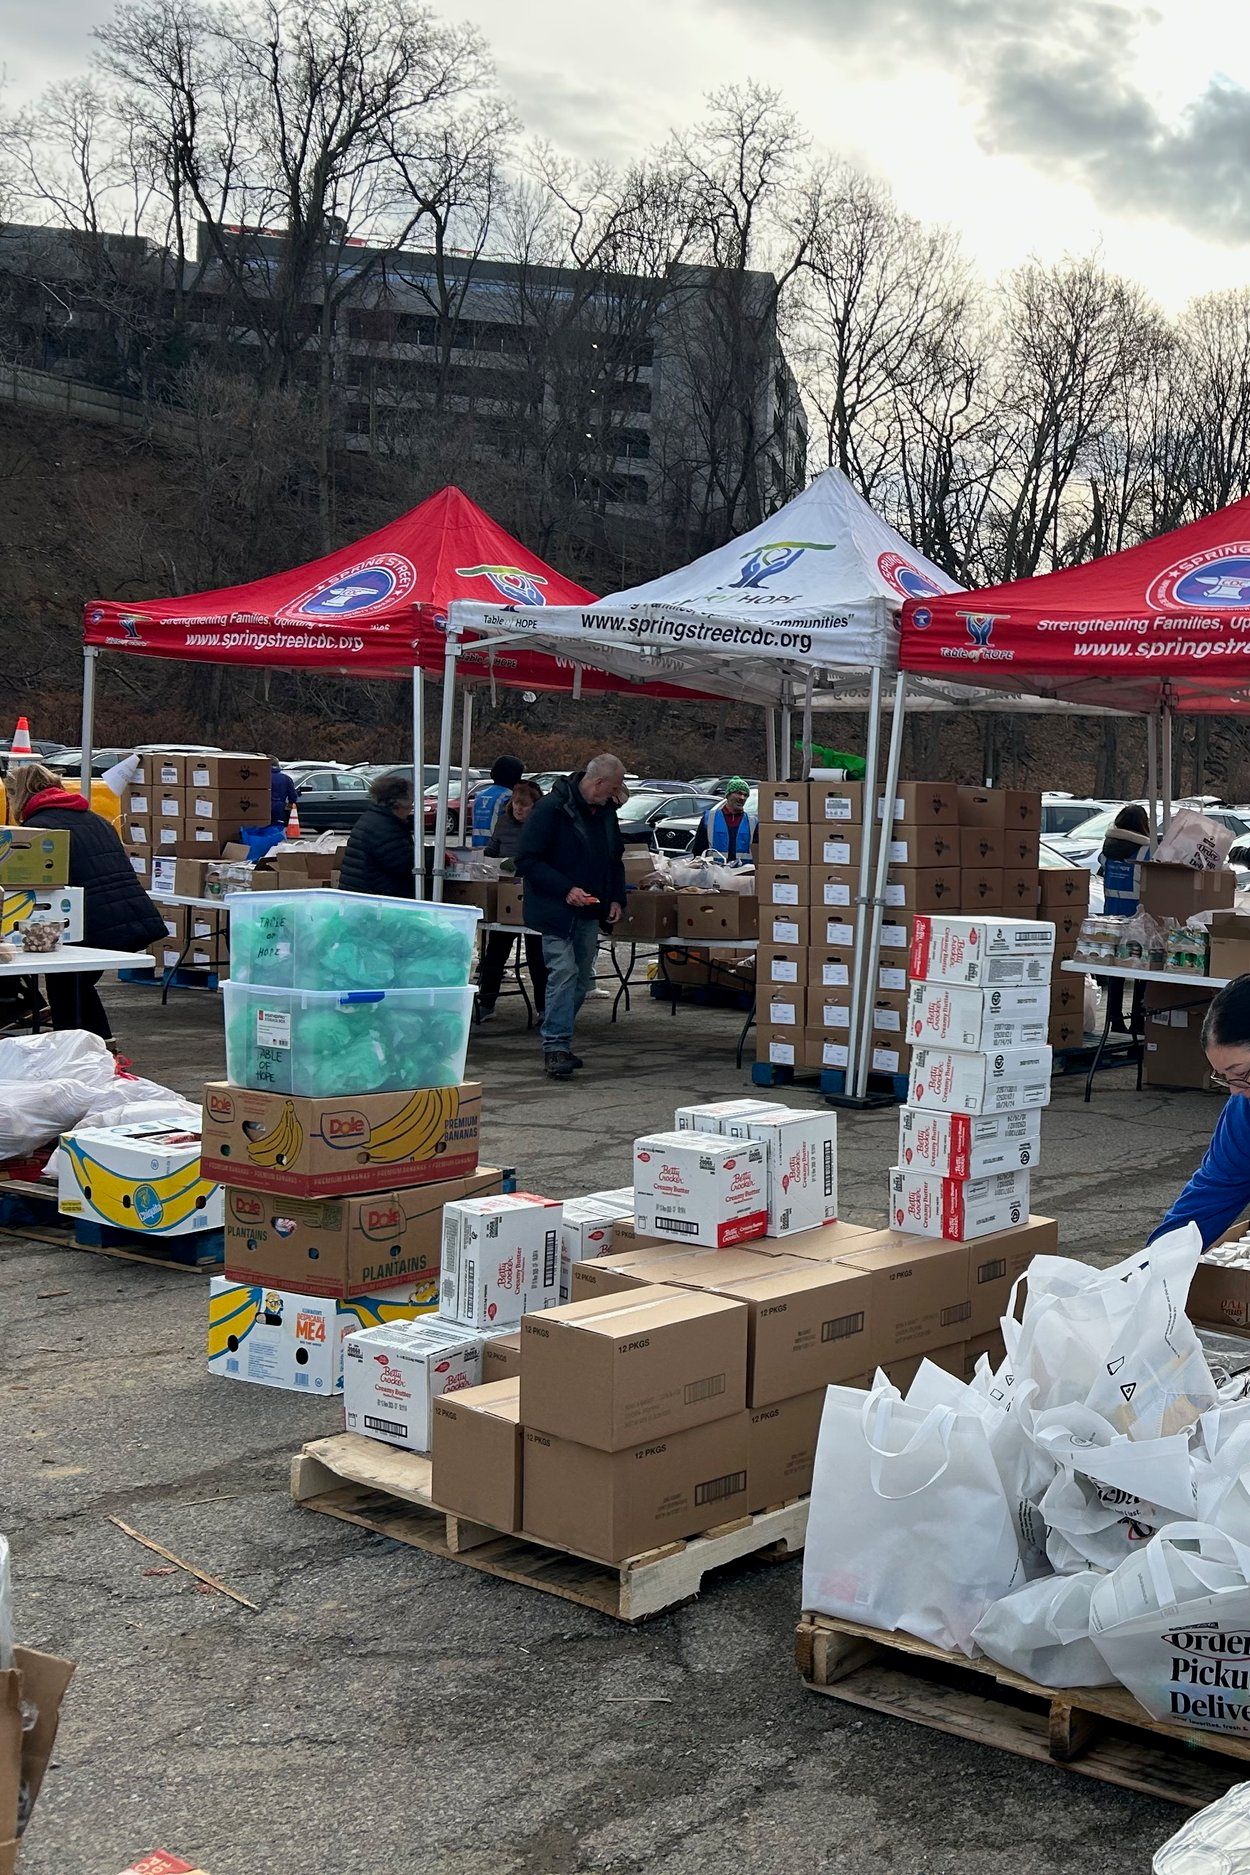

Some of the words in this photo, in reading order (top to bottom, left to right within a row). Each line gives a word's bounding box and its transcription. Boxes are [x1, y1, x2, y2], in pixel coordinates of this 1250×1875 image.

[329, 557, 385, 586] SPRING
[385, 556, 410, 589] STREET
[229, 611, 272, 626] Families,
[483, 614, 504, 627] Table
[516, 618, 538, 629] HOPE
[1037, 618, 1149, 636] Strengthening
[1153, 616, 1224, 633] Families,
[581, 613, 813, 654] www.springstreetcdc.org
[184, 632, 364, 653] www.springstreetcdc.org
[941, 647, 968, 659] Table
[983, 649, 1015, 661] HOPE
[958, 939, 966, 965] Betty
[927, 1002, 936, 1025] Betty
[932, 998, 942, 1031] Crocker
[259, 1061, 271, 1071] OF
[945, 1055, 953, 1078] Butter
[929, 1066, 938, 1090] Betty
[934, 1062, 944, 1095] Crocker
[942, 1079, 950, 1103] Creamy
[210, 1095, 231, 1111] Dole
[330, 1118, 364, 1135] Dole
[444, 1115, 478, 1129] PREMIUM
[444, 1127, 478, 1142] BANANAS
[917, 1130, 925, 1154] Betty
[921, 1126, 930, 1159] Crocker
[661, 1164, 680, 1179] Betty
[788, 1156, 798, 1181] Betty
[794, 1152, 802, 1183] Crocker
[658, 1172, 684, 1185] Crocker
[730, 1178, 756, 1192] Crocker
[733, 1171, 752, 1183] Betty
[653, 1183, 674, 1194] Creamy
[674, 1187, 690, 1196] Butter
[725, 1192, 745, 1203] Creamy
[745, 1188, 761, 1198] Butter
[140, 1203, 163, 1221] Chiquita
[236, 1197, 261, 1213] Dole
[368, 1208, 400, 1227] Dole
[227, 1225, 268, 1241] PLANTAINS
[362, 1255, 427, 1282] PLANTAINS
[497, 1261, 508, 1290] Betty
[504, 1256, 513, 1290] Crocker
[896, 1269, 913, 1279] PKGS
[514, 1268, 522, 1295] Creamy
[583, 1274, 597, 1284] PKGS
[769, 1304, 787, 1315] PKGS
[296, 1312, 326, 1324] DESPICABLE
[525, 1325, 532, 1333] 12
[533, 1327, 549, 1338] PKGS
[618, 1345, 627, 1354] 12
[628, 1339, 650, 1351] PKGS
[380, 1372, 406, 1387] Crocker
[383, 1366, 403, 1381] Betty
[446, 1371, 467, 1384] Betty
[374, 1384, 395, 1396] Creamy
[395, 1389, 412, 1398] Butter
[435, 1408, 442, 1416] 12
[442, 1409, 457, 1420] PKGS
[751, 1416, 759, 1424] 12
[760, 1409, 780, 1420] PKGS
[526, 1434, 534, 1442] 12
[534, 1436, 551, 1447] PKGS
[635, 1451, 644, 1460] 12
[645, 1444, 667, 1457] PKGS
